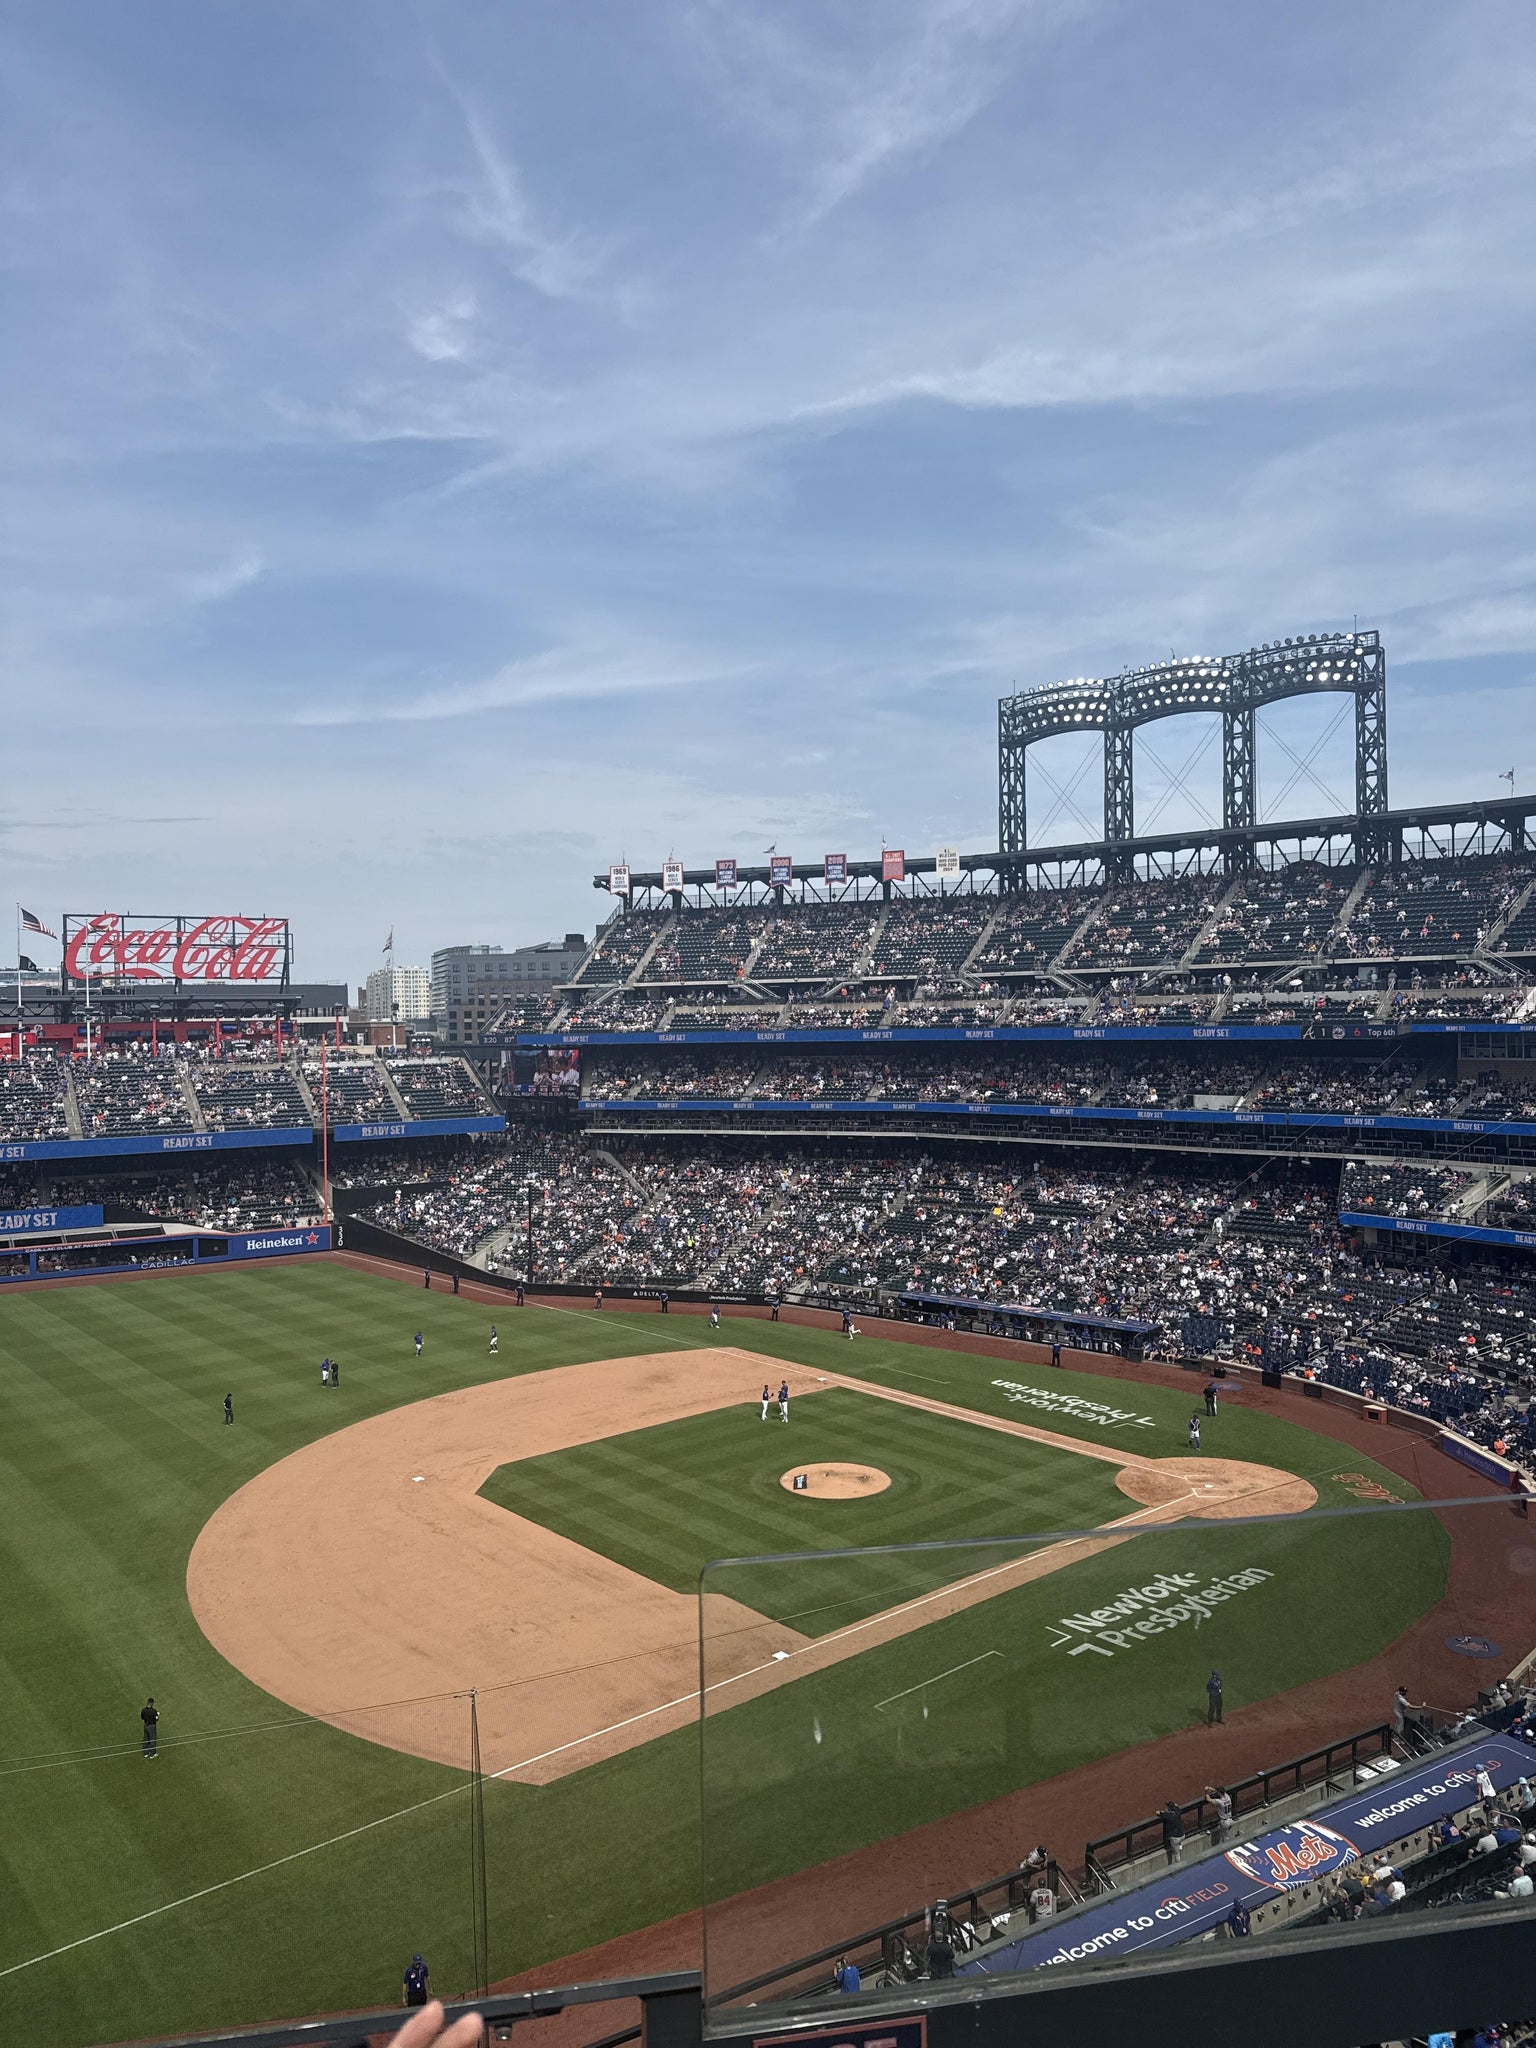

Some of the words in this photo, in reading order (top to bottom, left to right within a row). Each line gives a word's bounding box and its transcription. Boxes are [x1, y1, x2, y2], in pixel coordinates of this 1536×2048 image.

[65, 914, 289, 980] Coca-Cola
[1194, 1029, 1214, 1037] READY
[1216, 1029, 1229, 1037] SET
[1322, 1028, 1325, 1036] 1
[1354, 1028, 1360, 1036] 6
[1368, 1028, 1381, 1038] Top
[1383, 1028, 1396, 1036] 6th
[1236, 1114, 1252, 1122] READY
[1254, 1114, 1264, 1122] SET
[362, 1126, 389, 1136] READY
[390, 1125, 405, 1134] SET
[1453, 1122, 1472, 1131] READY
[1473, 1122, 1484, 1131] SET
[163, 1138, 193, 1149] READY
[196, 1136, 213, 1147] SET
[7, 1147, 25, 1158] SET
[33, 1212, 57, 1227] SET
[1396, 1221, 1414, 1230] READY
[1416, 1223, 1427, 1232] SET
[246, 1236, 302, 1250] Heineken
[141, 1259, 196, 1269] CADILLAC
[990, 1379, 1137, 1420] Presbyterian
[1060, 1572, 1200, 1633] NewYork-
[1094, 1568, 1275, 1648] Presbyterian
[1354, 1792, 1428, 1828] welcome
[1424, 1784, 1447, 1800] to
[1444, 1771, 1474, 1788] citi
[1265, 1834, 1338, 1880] Mets
[1037, 1896, 1050, 1906] 84
[1127, 1915, 1154, 1931] to
[1155, 1896, 1190, 1920] citi
[1188, 1882, 1229, 1906] FIELD
